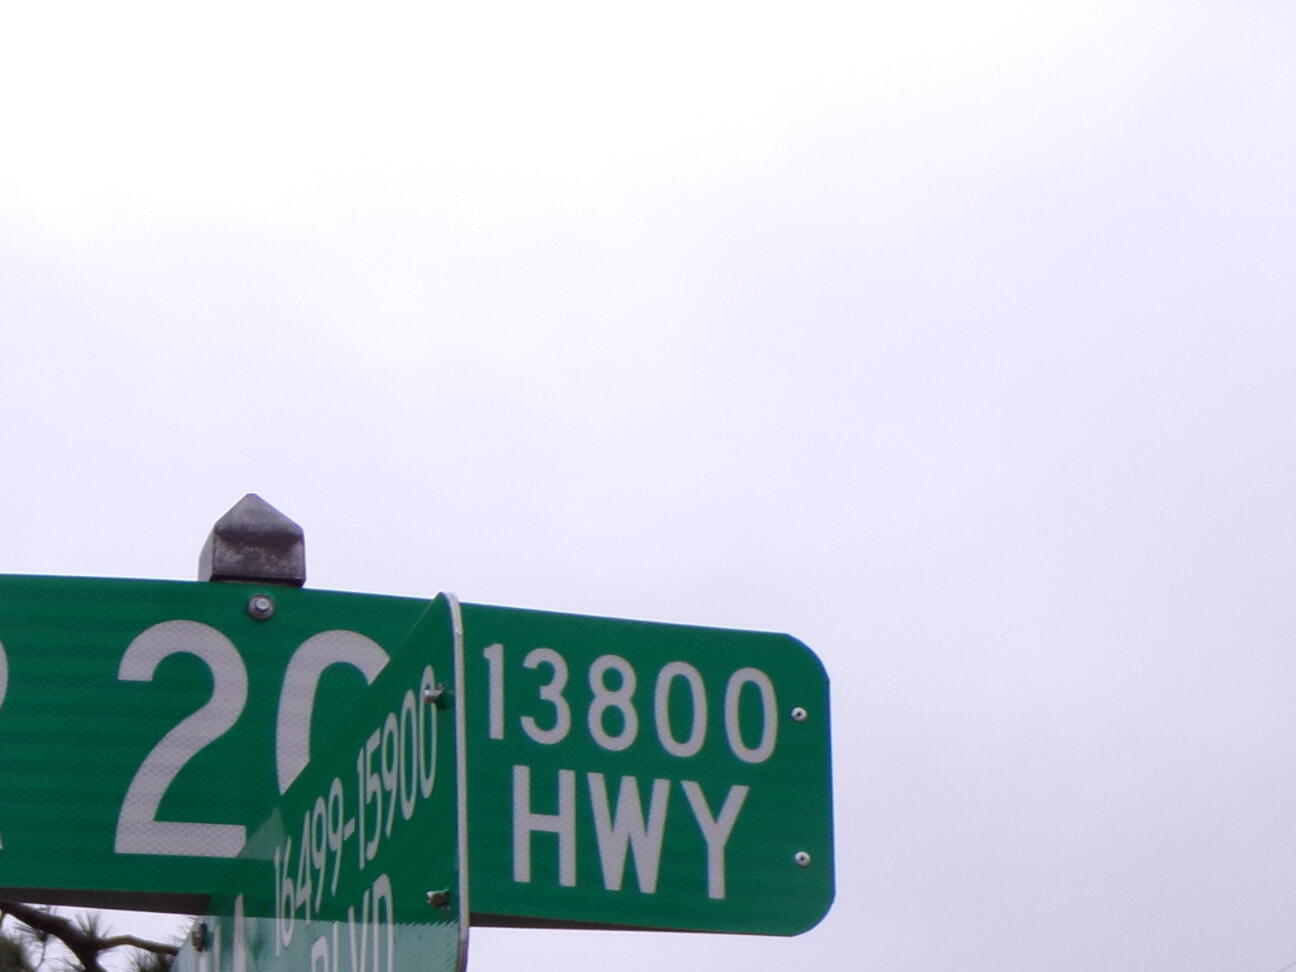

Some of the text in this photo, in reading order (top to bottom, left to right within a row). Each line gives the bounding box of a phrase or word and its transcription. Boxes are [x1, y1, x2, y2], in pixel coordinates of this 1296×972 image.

[483, 643, 779, 764] 13800
[274, 664, 437, 957] 16499-15900
[513, 764, 750, 900] HWY
